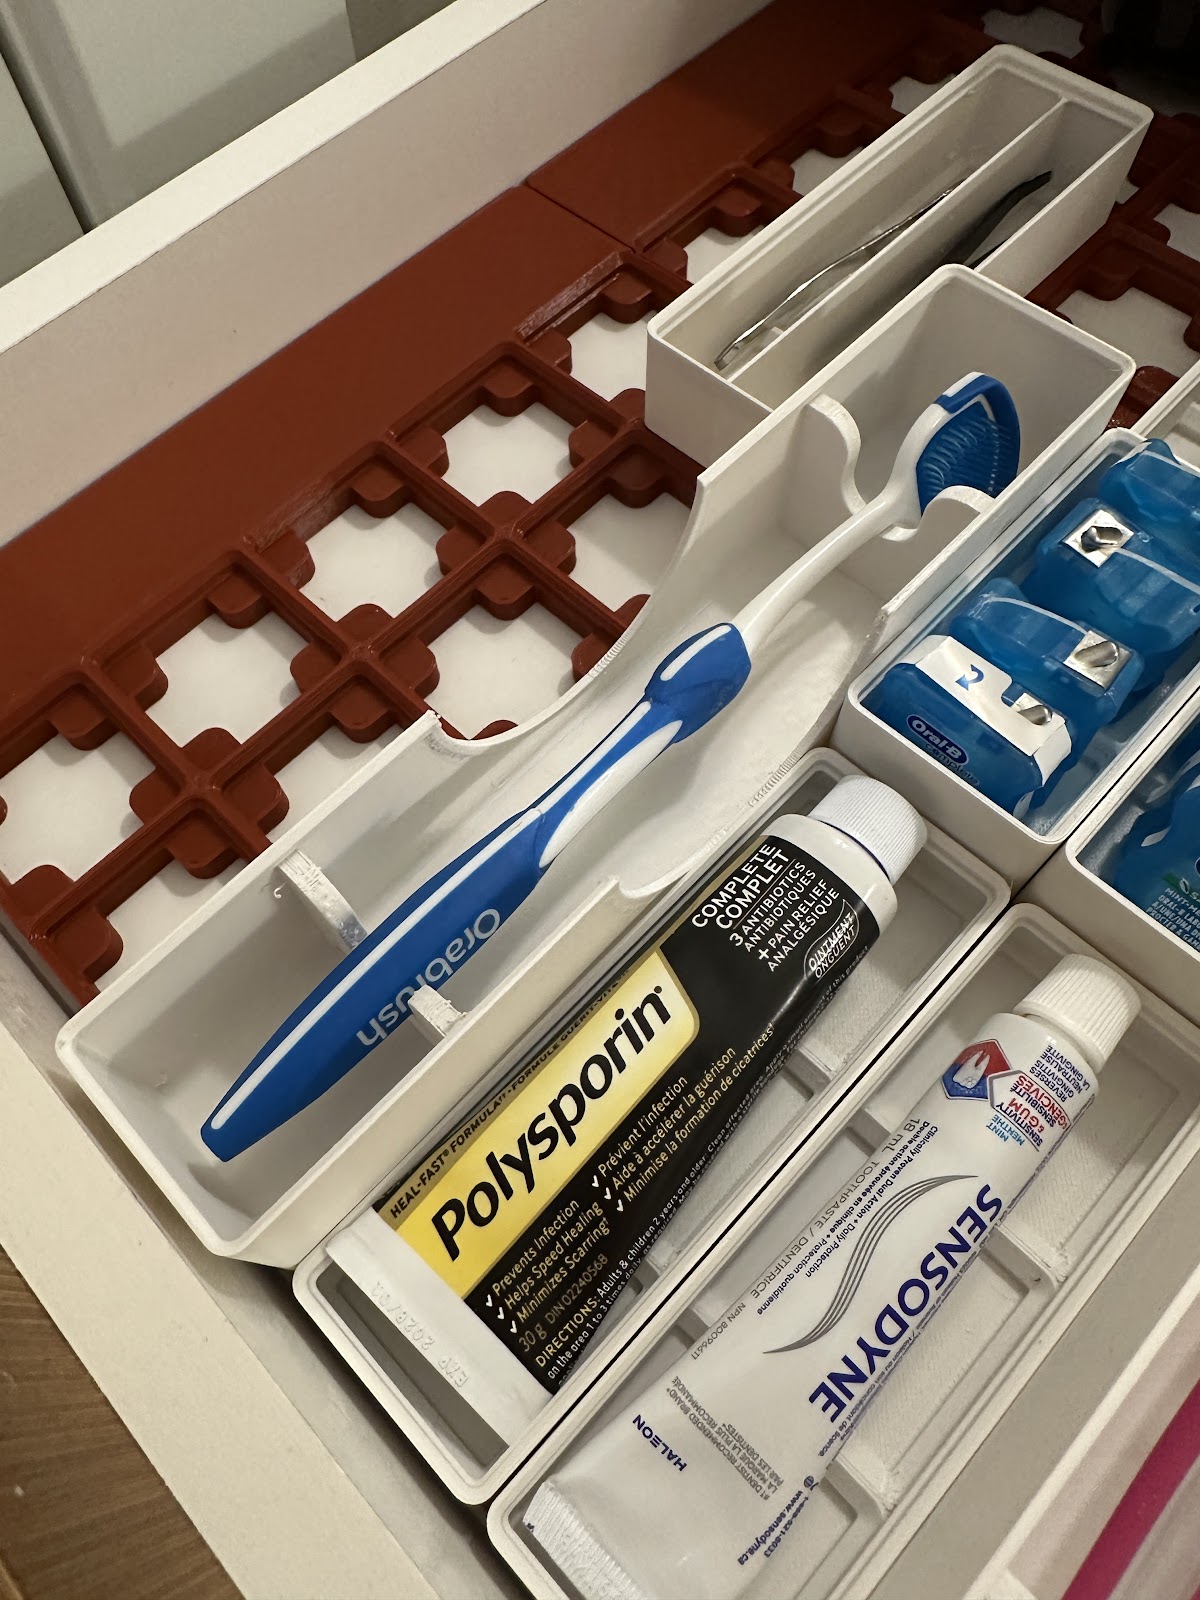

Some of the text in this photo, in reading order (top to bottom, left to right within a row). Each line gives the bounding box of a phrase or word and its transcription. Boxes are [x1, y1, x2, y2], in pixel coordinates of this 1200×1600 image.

[911, 720, 962, 760] Oral-B
[691, 844, 776, 928] COMPLETE
[715, 848, 789, 929] COMPLET
[729, 861, 806, 947] 3 ANTIBIOTICS
[744, 869, 816, 953] ANTIBIOTIQUES
[758, 878, 827, 960] + PAIN RELIEF
[767, 887, 840, 972] ANALGÉSIQUE
[806, 911, 856, 971] OINTMENT
[812, 923, 858, 978] ONGUENT
[356, 907, 501, 1047] Orabrush
[1027, 1065, 1069, 1102] REVERSES
[1032, 1059, 1076, 1098] GINGIVITIS
[1038, 1051, 1085, 1093] NEUTRALISE
[1080, 1080, 1091, 1090] LA
[612, 1047, 736, 1191] Aide à accélérer la guérison
[1007, 1097, 1045, 1133] & GUM
[1008, 1082, 1059, 1127] SENSIBILITÉ
[1013, 1074, 1069, 1125] GENCIVES
[623, 1151, 669, 1203] Minimise
[664, 1140, 679, 1154] la
[674, 1089, 722, 1143] formation
[720, 1075, 734, 1092] de
[881, 1131, 904, 1157] mL
[902, 1114, 921, 1134] 18
[907, 1120, 931, 1145] Double
[909, 1125, 938, 1157] Clinically
[985, 1120, 1009, 1142] MINT
[990, 1113, 1025, 1145] MENTHE
[993, 1100, 1045, 1146] SENSITIVITY
[597, 1128, 642, 1178] Prévient
[888, 1144, 909, 1166] action
[889, 1155, 914, 1180] Proven
[814, 1158, 880, 1231] TOOTHPASTE
[852, 1196, 863, 1207] en
[861, 1165, 891, 1197] éprouvée
[875, 1178, 894, 1198] Dual
[829, 1206, 855, 1234] clinique
[856, 1194, 879, 1219] Action
[491, 1200, 580, 1297] Prevents Infection
[535, 1295, 601, 1368] DIRECTIONS:
[597, 1268, 623, 1299] Adults
[618, 1259, 629, 1270] &
[627, 1225, 656, 1261] children
[652, 1217, 661, 1226] 2
[659, 1194, 684, 1220] years
[677, 1176, 695, 1195] and
[705, 1127, 726, 1152] Clean
[836, 1222, 856, 1243] Daily
[504, 1201, 604, 1310] Helps Speed Healing
[749, 1234, 808, 1300] DENTIFRICE
[793, 1237, 828, 1274] Protection
[805, 1240, 840, 1278] Protection
[516, 1266, 568, 1323] Minimizes
[518, 1253, 608, 1353] 30 g DIN 02240568
[726, 1301, 747, 1323] NPN
[756, 1273, 795, 1315] quotidienne
[809, 1184, 1004, 1423] SENSODYNE
[547, 1365, 560, 1379] on
[555, 1350, 573, 1368] the
[570, 1330, 589, 1352] area
[586, 1322, 594, 1330] 1
[592, 1313, 603, 1323] to
[599, 1304, 608, 1312] 3
[604, 1278, 626, 1305] times
[688, 1317, 730, 1364] 80096611
[435, 1353, 470, 1387] EXP
[632, 1414, 688, 1472] HALEON
[668, 1376, 778, 1493] LA MARQUE LA PLUS RECOMMANDÉE
[686, 1411, 739, 1464] RECOMMENDED
[732, 1461, 764, 1492] DENTIST
[756, 1457, 772, 1473] LES
[767, 1469, 784, 1486] PAR
[737, 1490, 803, 1566] www.sensodyne.ca
